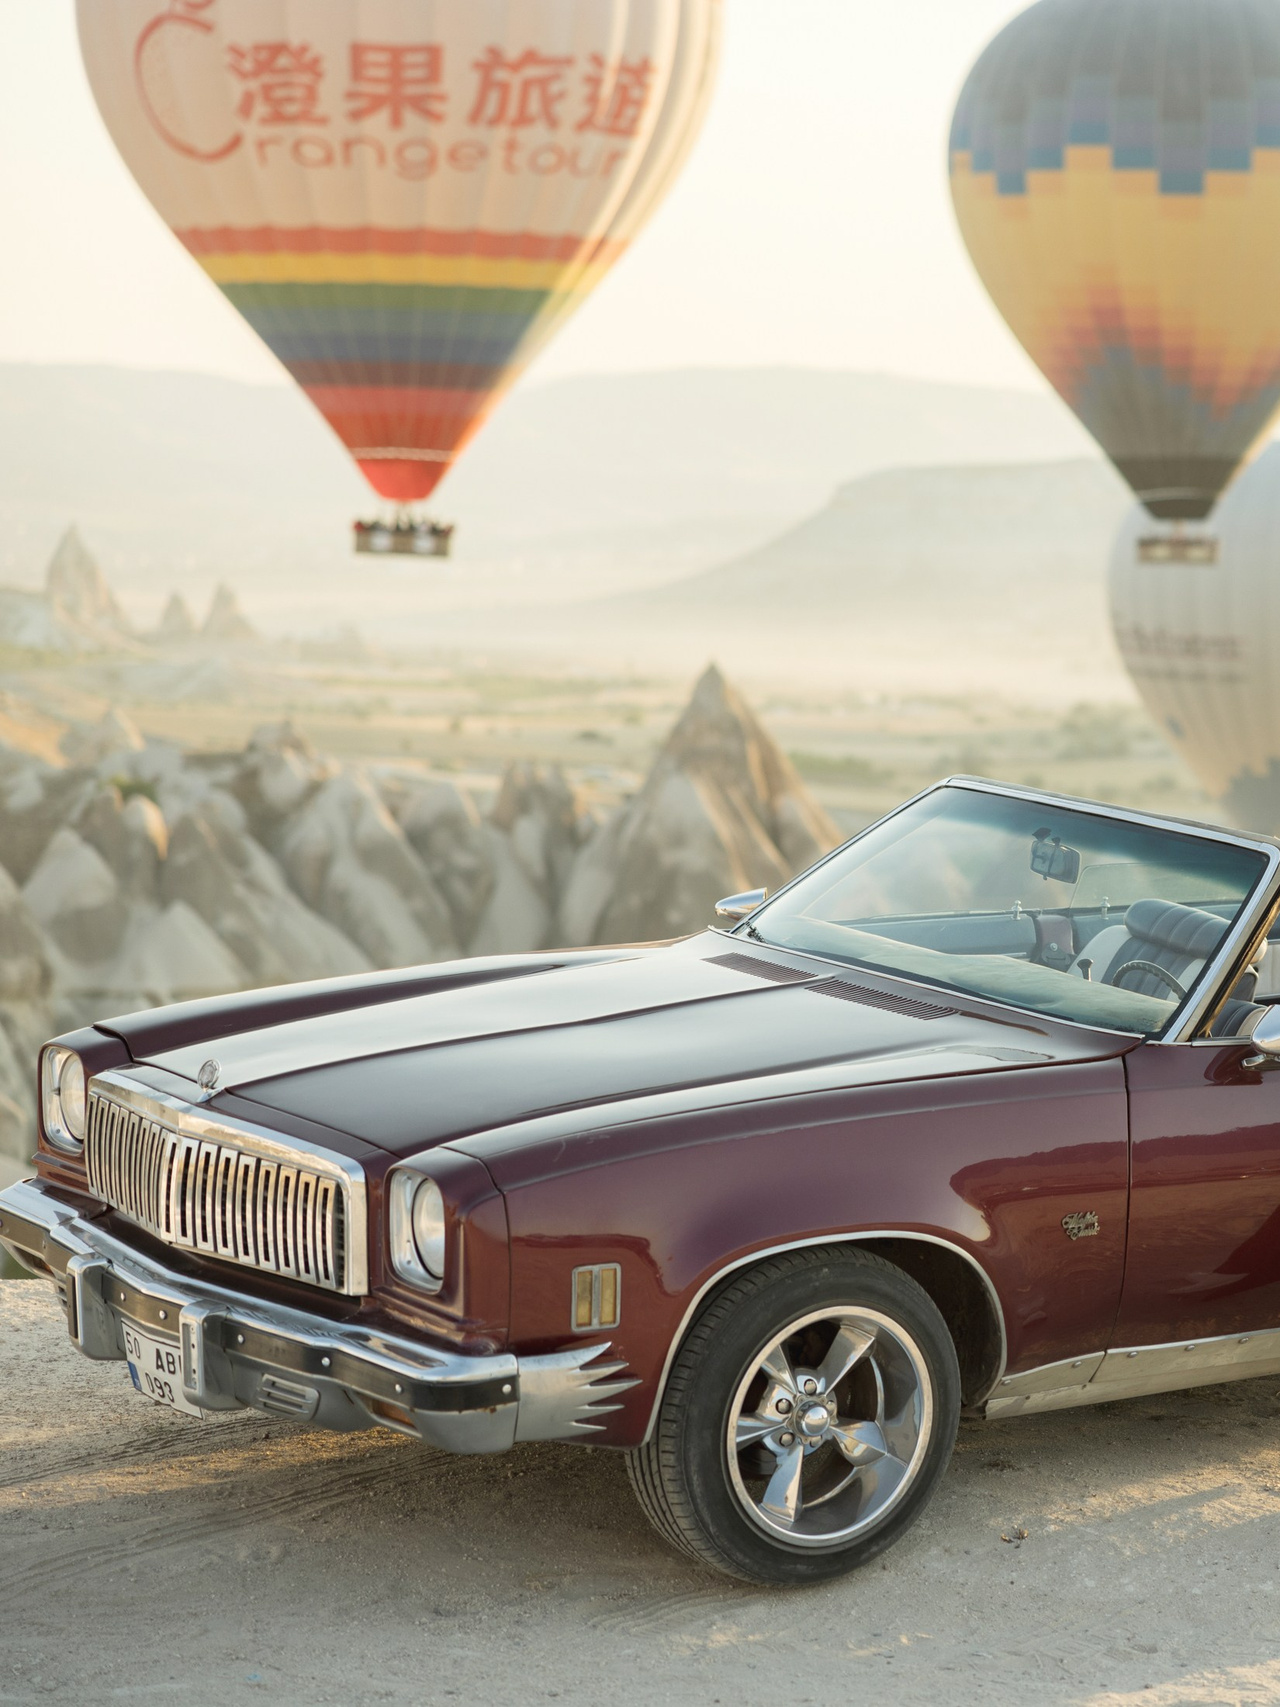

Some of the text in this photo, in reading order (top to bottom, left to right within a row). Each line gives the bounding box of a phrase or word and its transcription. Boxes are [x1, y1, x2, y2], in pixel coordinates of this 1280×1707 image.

[125, 1331, 182, 1375] 50 AB
[145, 1372, 174, 1403] 093
